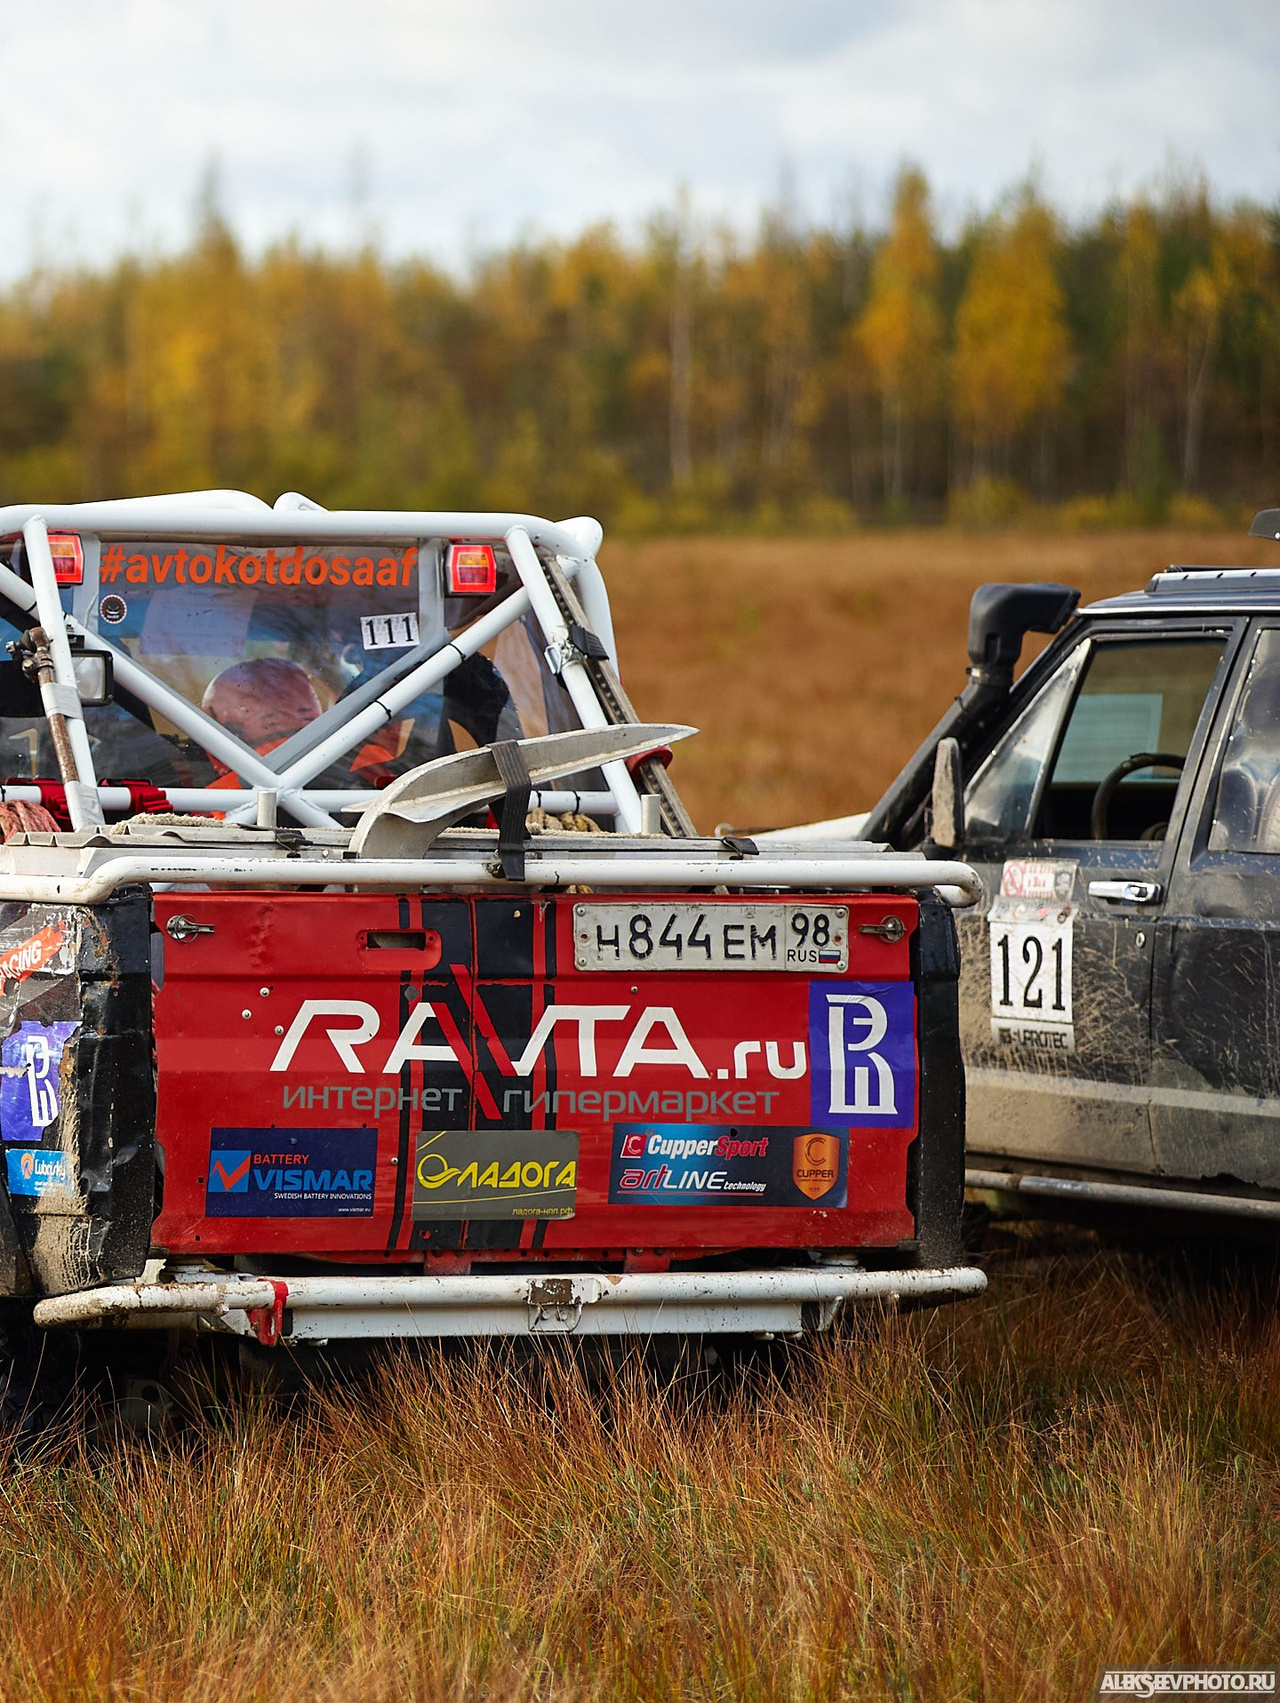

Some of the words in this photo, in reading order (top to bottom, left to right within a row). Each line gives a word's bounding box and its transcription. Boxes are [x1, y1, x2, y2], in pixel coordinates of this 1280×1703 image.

[100, 544, 419, 587] #avtokotdosaaf
[365, 615, 415, 646] 111
[790, 912, 830, 948] 98
[787, 949, 817, 963] RUS
[996, 934, 1066, 1011] 121
[270, 999, 807, 1080] RAVTA.ru
[283, 1085, 463, 1119] интернет
[502, 1087, 780, 1121] гипермаркет
[253, 1153, 310, 1165] BATTERY
[647, 1134, 769, 1160] CupperSport
[253, 1169, 373, 1191] VISMAR
[457, 1160, 577, 1188] ЛАДОГА
[620, 1163, 728, 1190] artLINE
[723, 1180, 767, 1192] technology
[796, 1169, 834, 1178] CUPPER
[274, 1192, 302, 1200] SWEDISH
[303, 1192, 329, 1200] BATTERY
